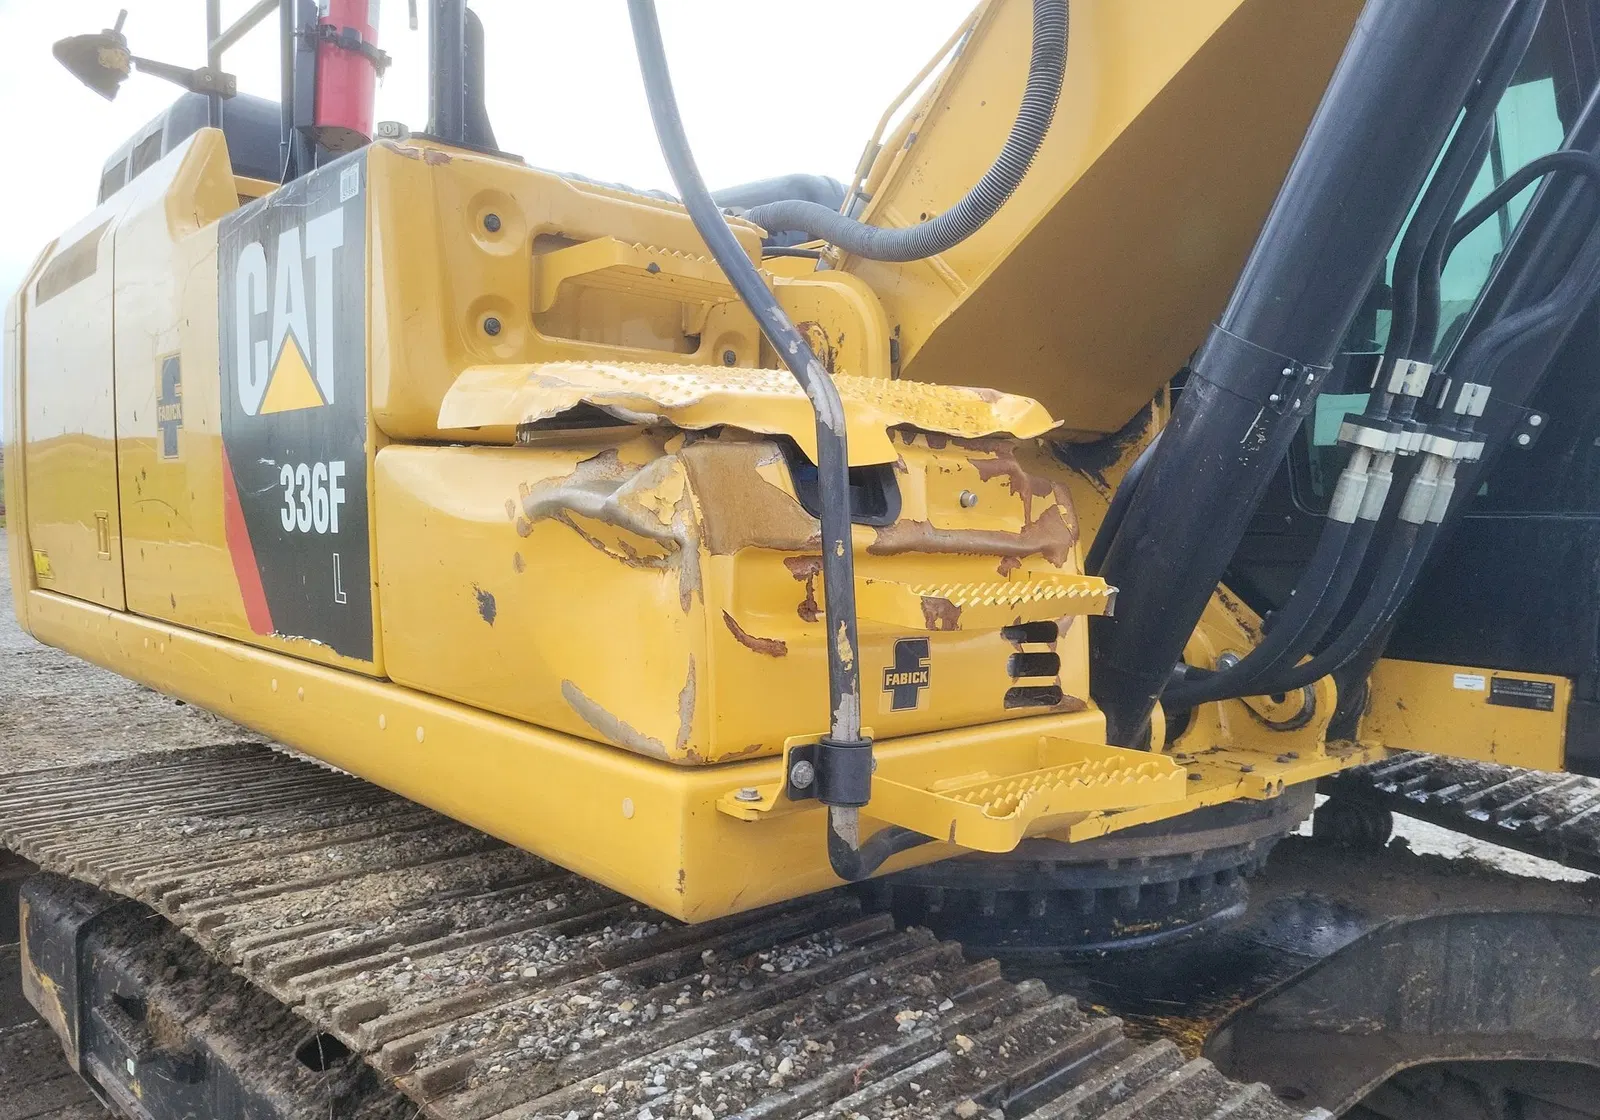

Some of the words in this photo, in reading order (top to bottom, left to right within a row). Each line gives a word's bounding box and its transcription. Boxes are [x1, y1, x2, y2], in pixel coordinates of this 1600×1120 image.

[236, 207, 344, 416] CAT
[280, 461, 346, 534] 336F
[333, 553, 347, 604] L
[885, 671, 928, 686] FABICK
